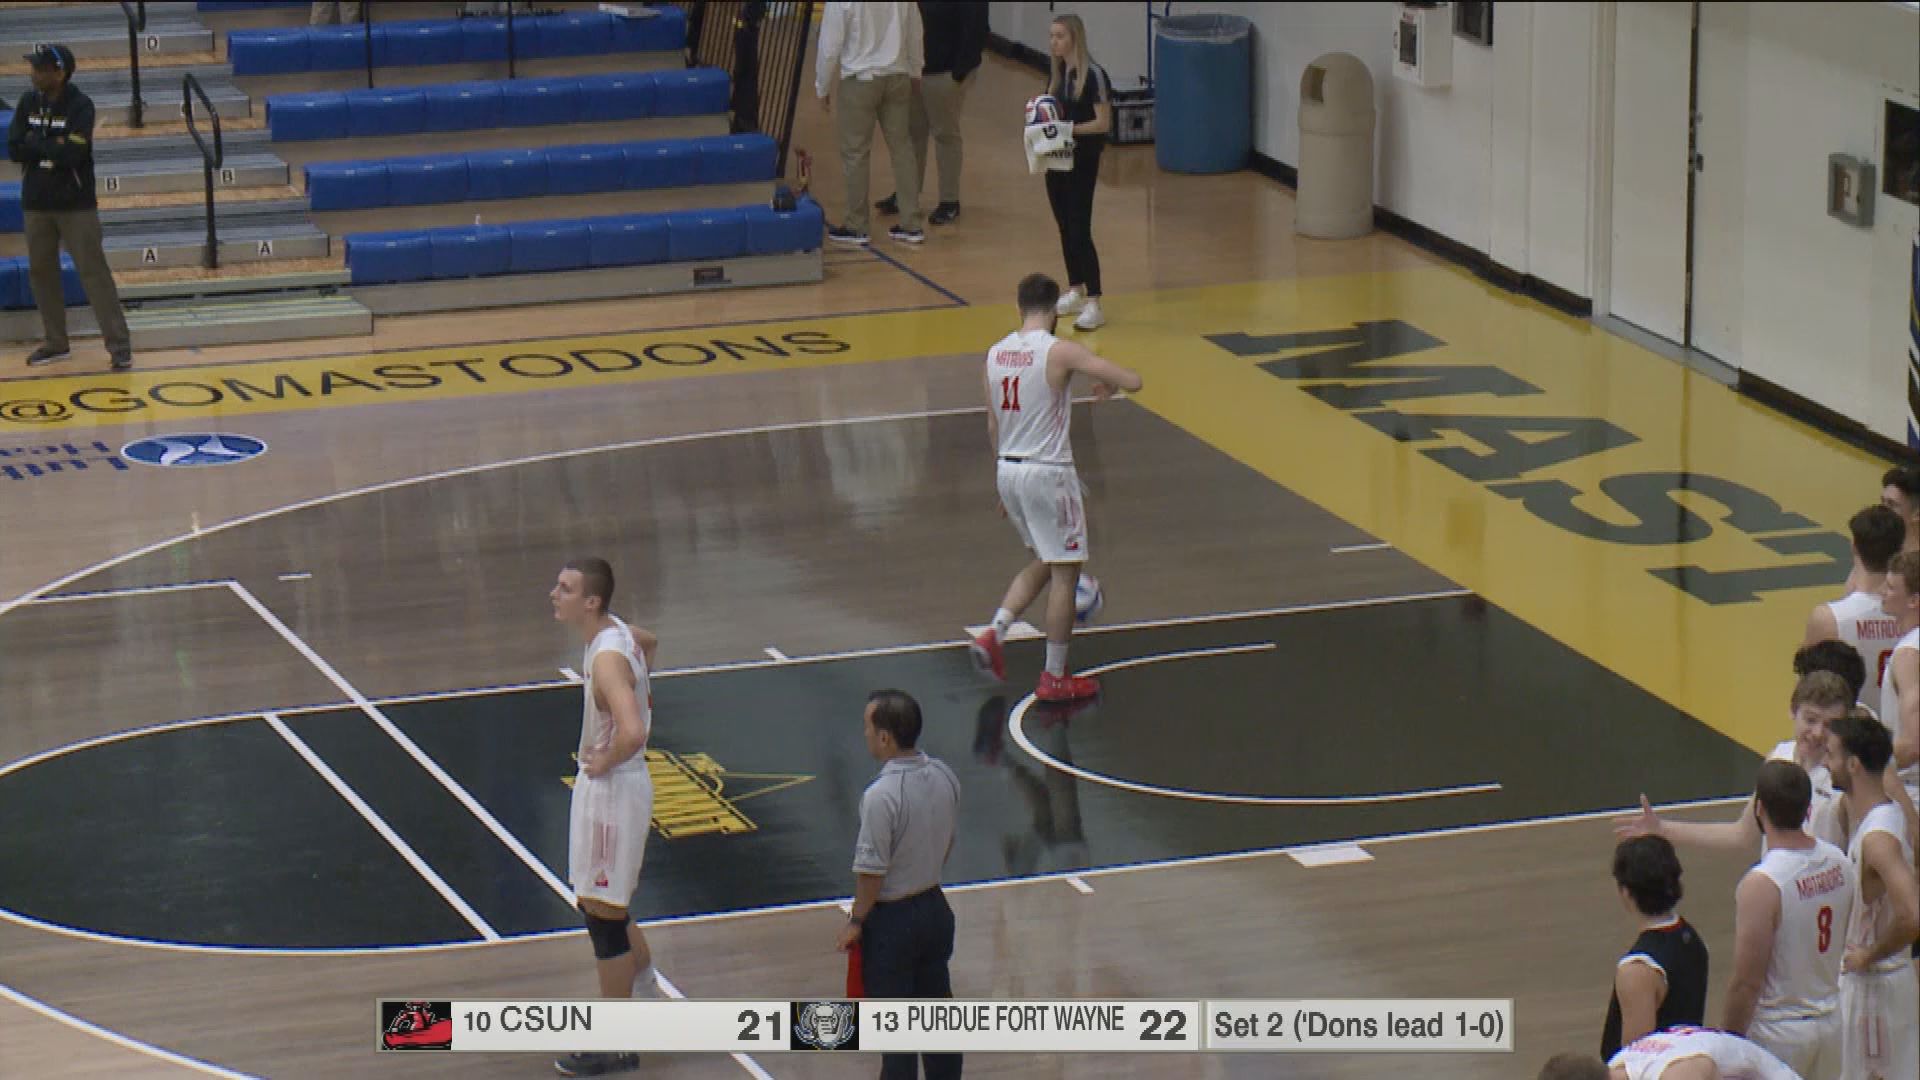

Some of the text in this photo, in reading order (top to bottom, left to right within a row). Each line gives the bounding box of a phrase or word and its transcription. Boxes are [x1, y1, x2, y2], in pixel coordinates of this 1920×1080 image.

[144, 249, 156, 263] A
[260, 242, 271, 255] A
[0, 331, 850, 424] @GOMASTODONS
[1002, 376, 1020, 411] 11
[1796, 864, 1844, 900] MATADORS
[1818, 906, 1832, 952] 8
